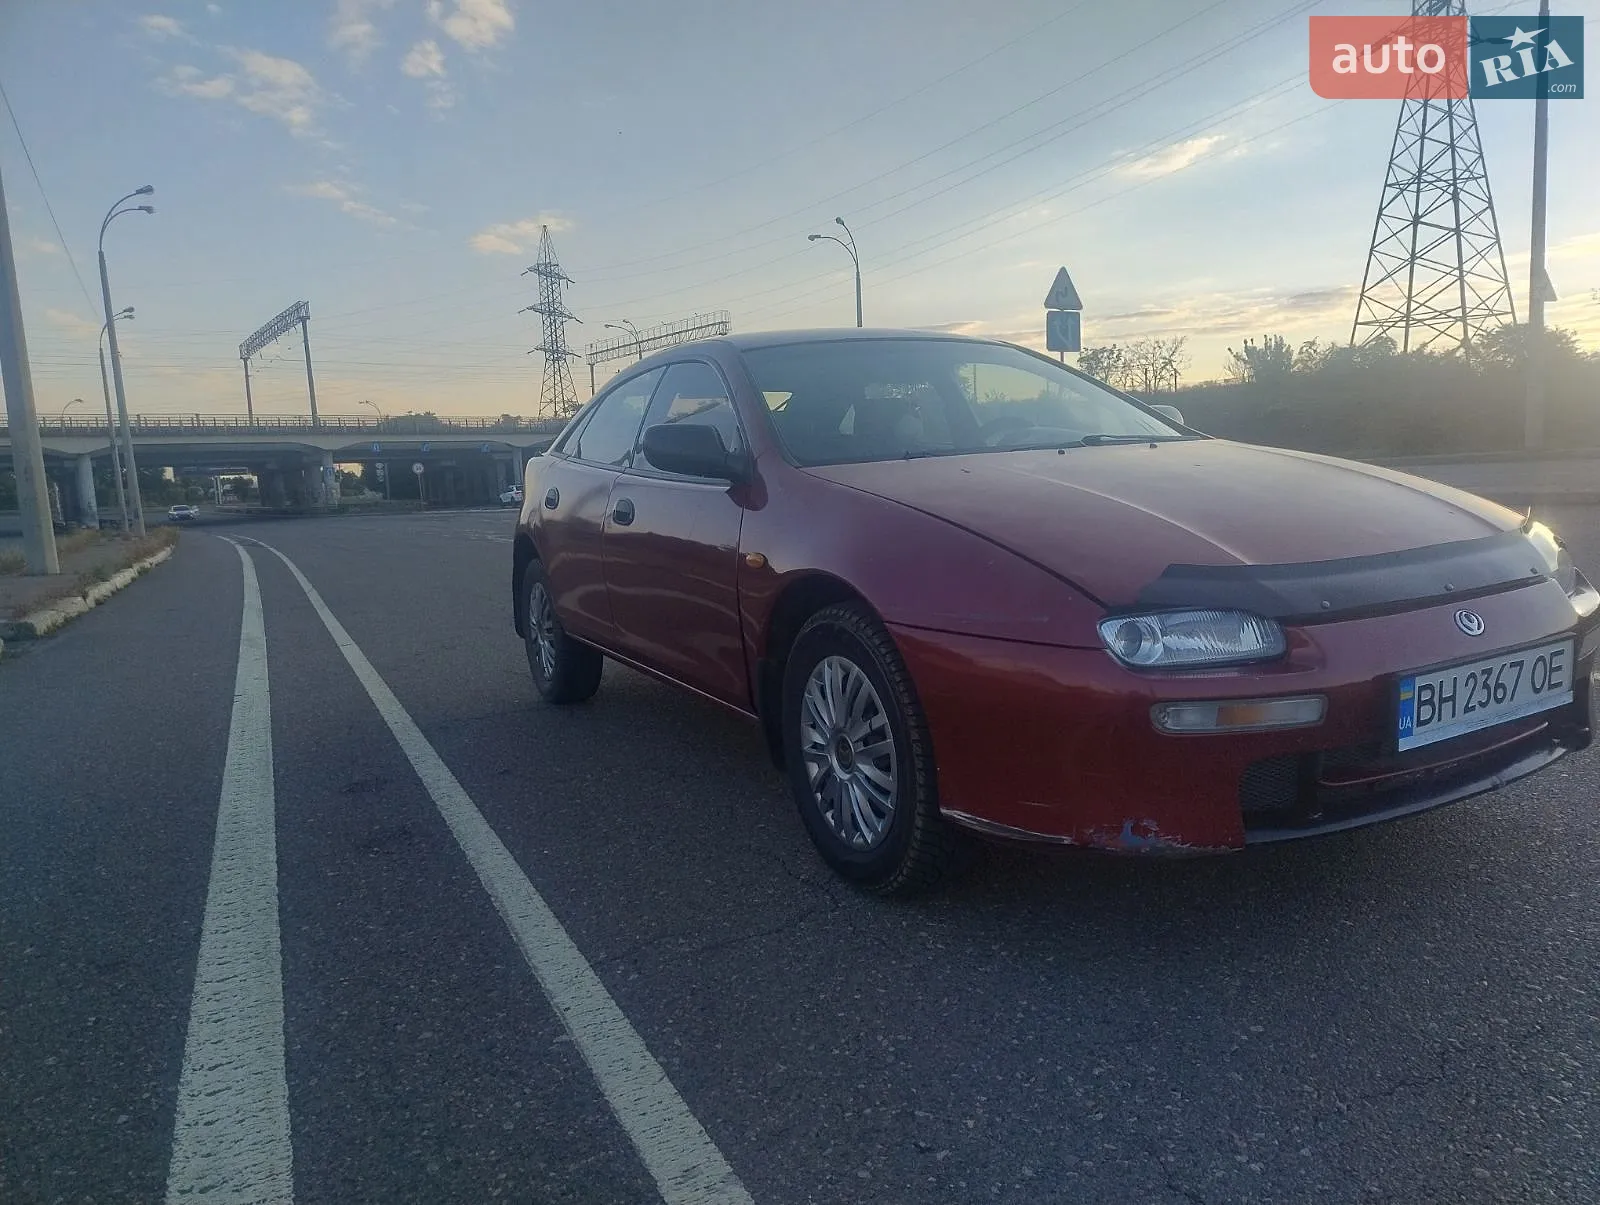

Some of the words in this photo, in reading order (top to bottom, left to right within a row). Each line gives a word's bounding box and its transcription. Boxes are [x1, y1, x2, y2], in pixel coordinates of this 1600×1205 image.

[1416, 676, 1458, 728] BH
[1463, 659, 1525, 714] 2367
[1530, 649, 1565, 694] OE
[1399, 715, 1413, 730] UA
